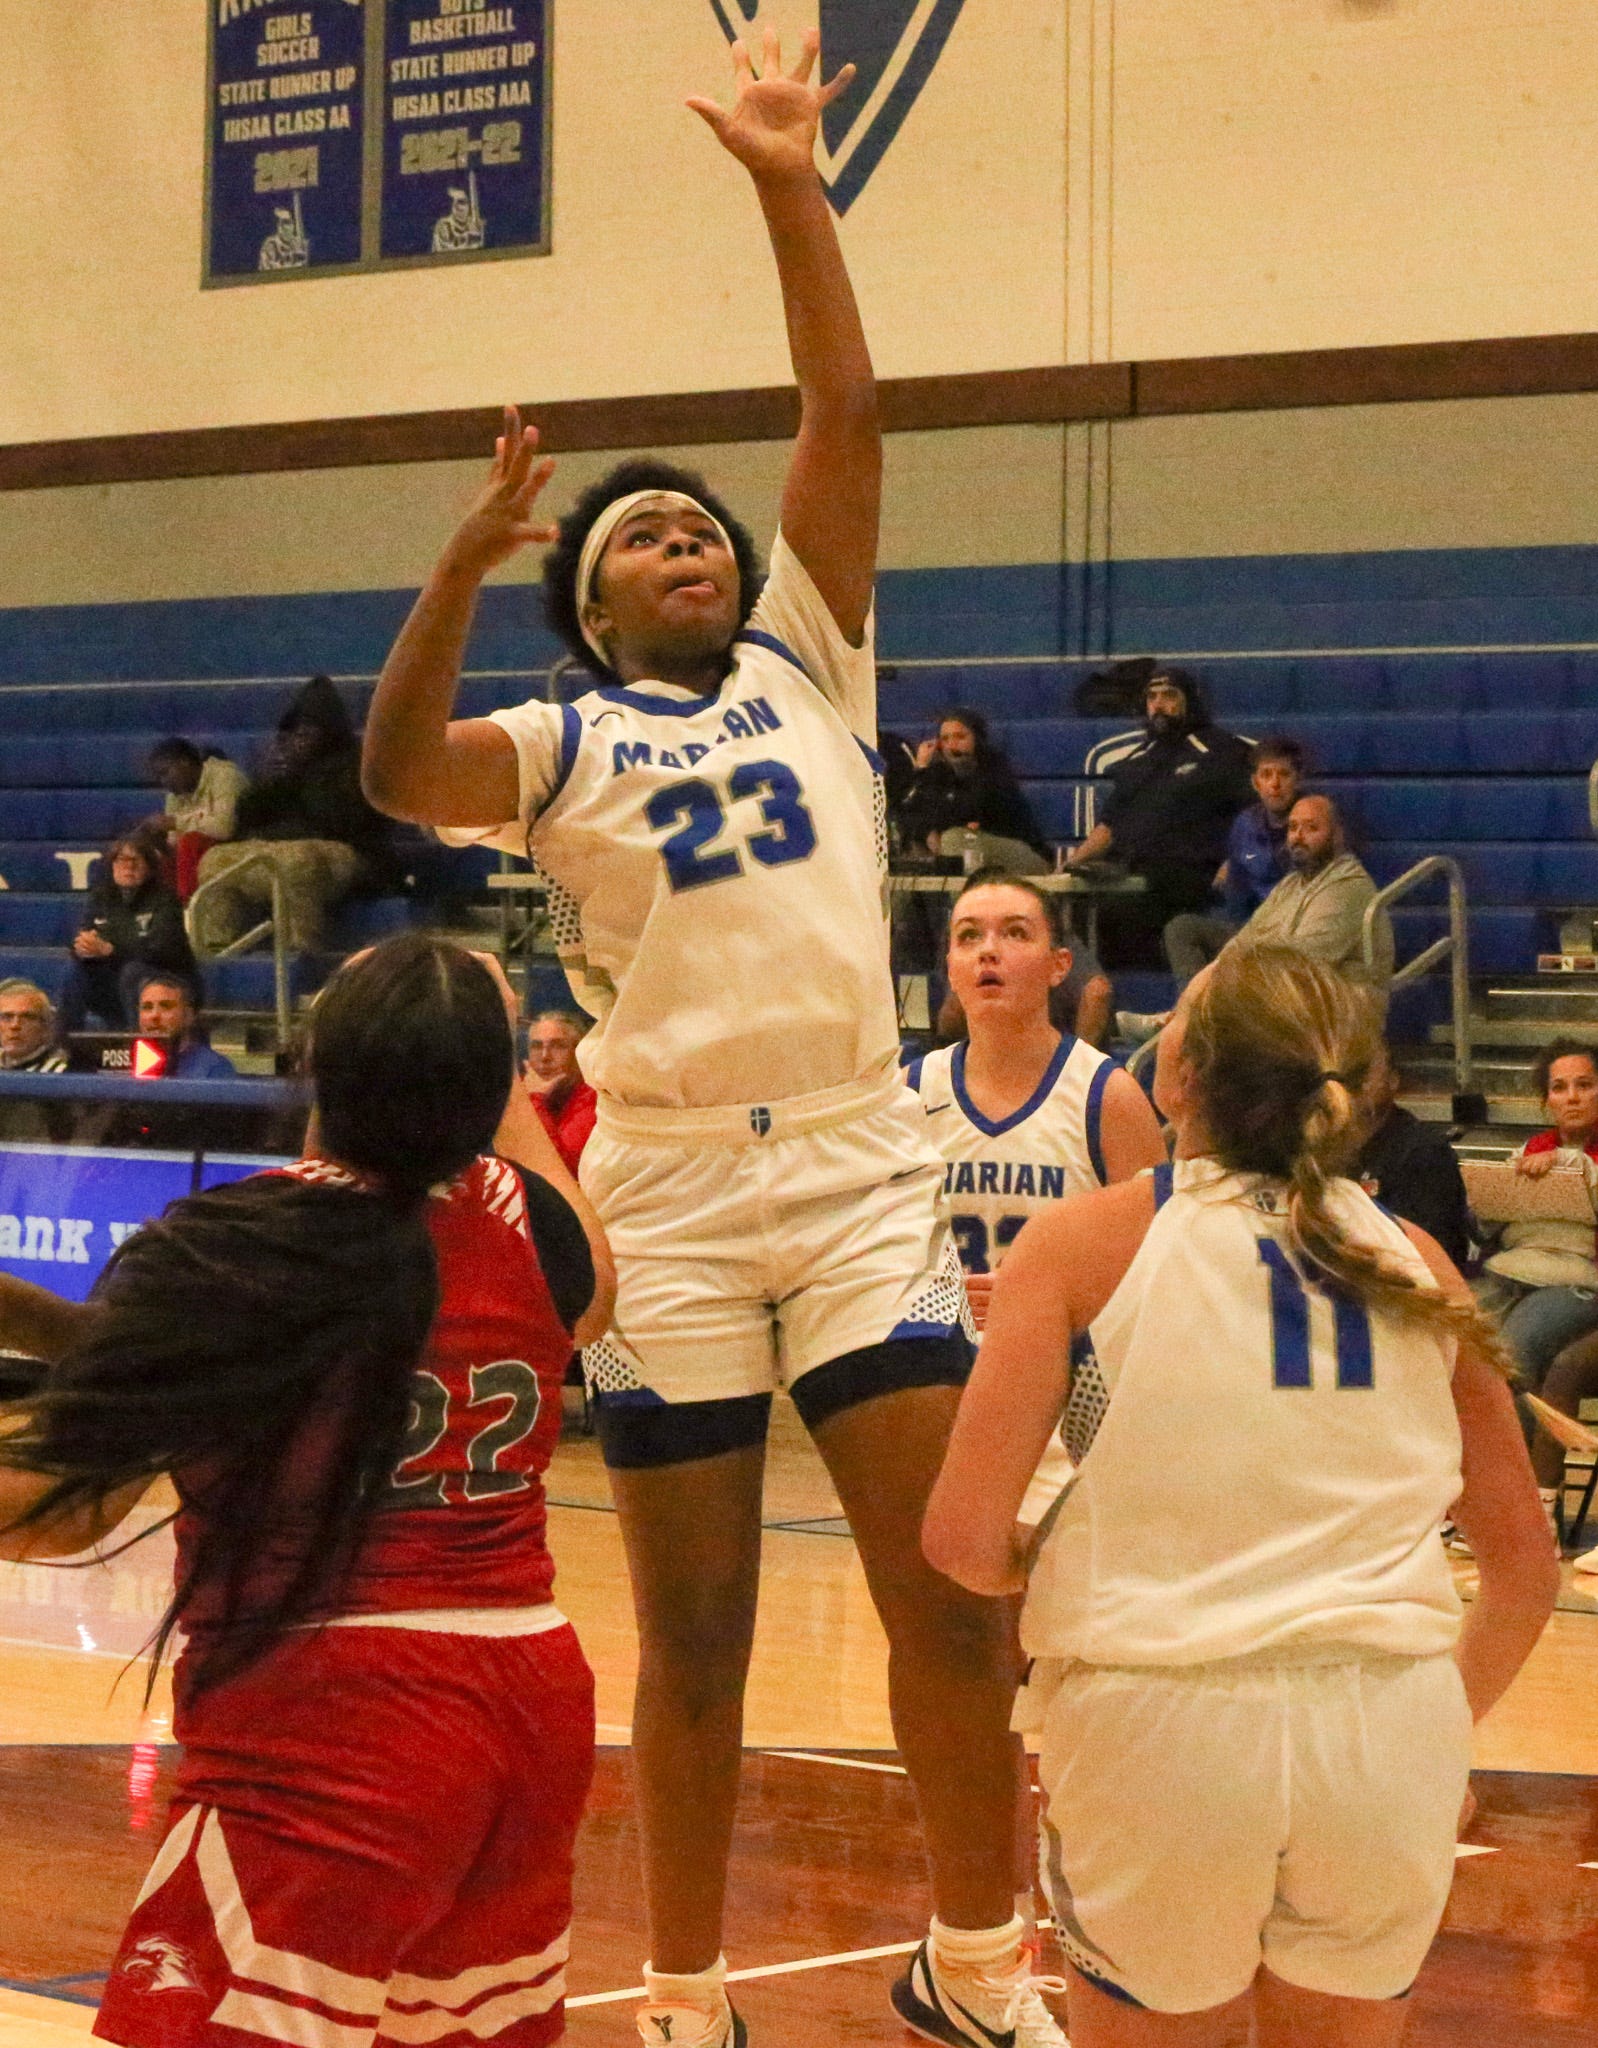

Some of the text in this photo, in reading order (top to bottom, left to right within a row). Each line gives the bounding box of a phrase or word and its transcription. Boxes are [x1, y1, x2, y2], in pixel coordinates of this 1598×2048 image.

[265, 12, 312, 41] GIRLS
[410, 8, 516, 45] BASKETBALL
[257, 36, 320, 67] SOCCER
[391, 40, 536, 83] STATE RUNNER UP
[220, 65, 357, 106] STATE RUNNER UP
[393, 79, 531, 121] IHSAA CLASS AAA
[224, 103, 350, 143] IHSAA CLASS AA
[612, 696, 783, 777] MARAN
[642, 758, 819, 896] 23
[943, 1161, 1065, 1198] ARIAN
[1255, 1234, 1375, 1390] 11
